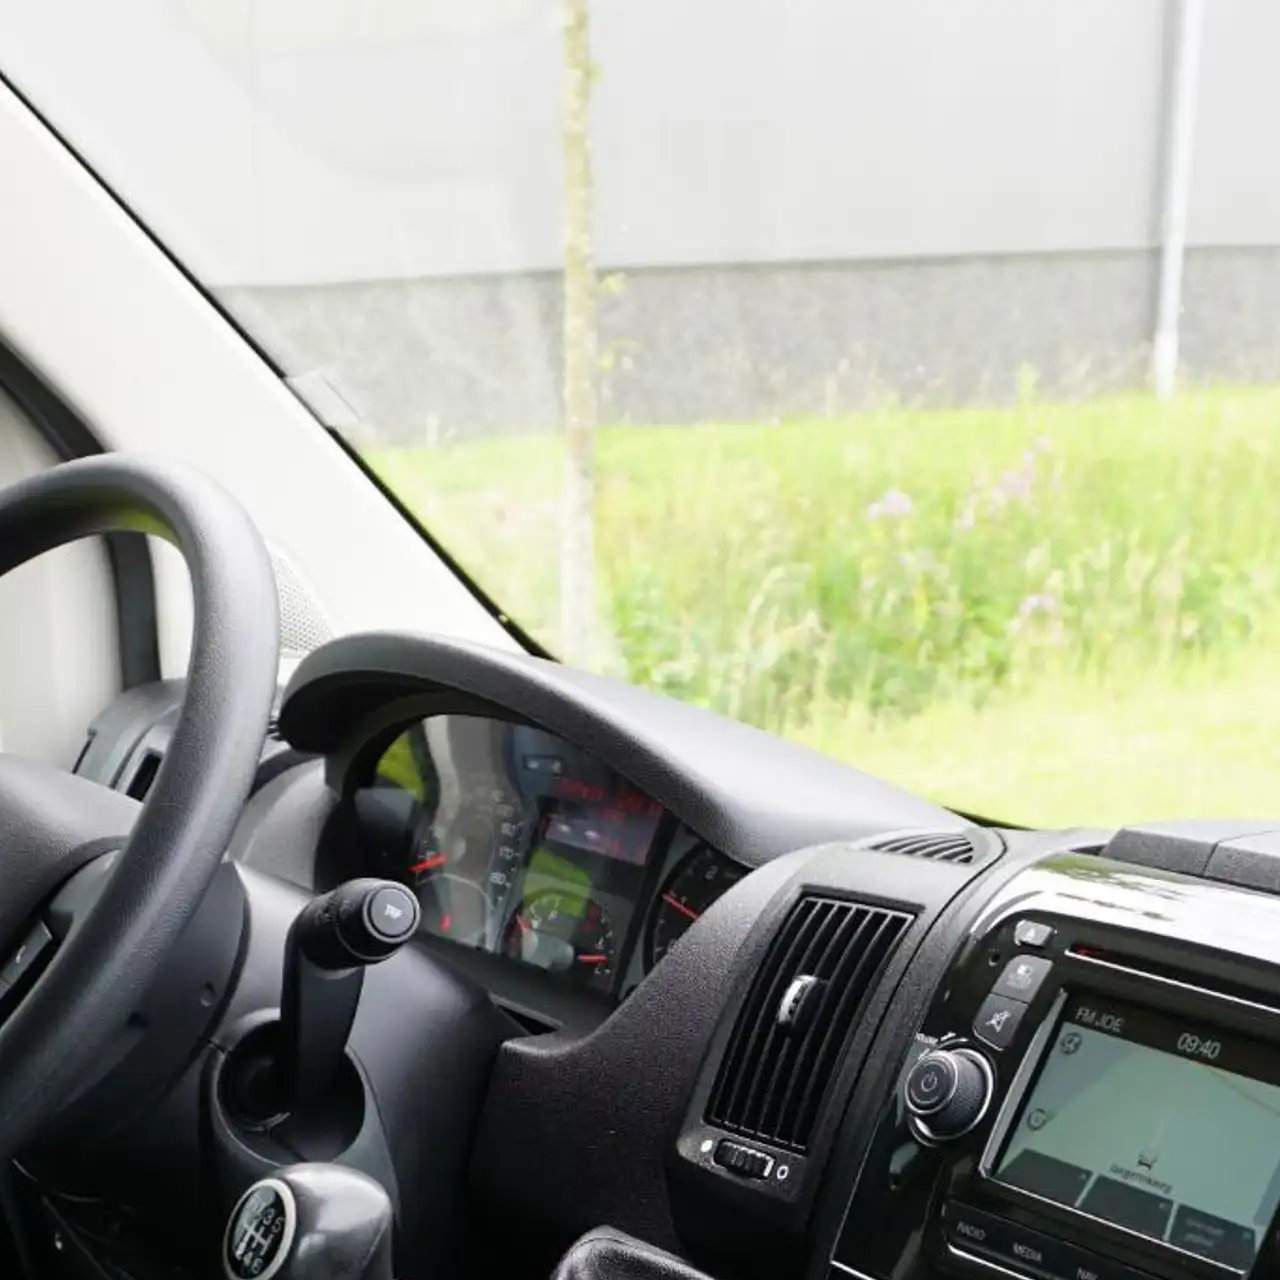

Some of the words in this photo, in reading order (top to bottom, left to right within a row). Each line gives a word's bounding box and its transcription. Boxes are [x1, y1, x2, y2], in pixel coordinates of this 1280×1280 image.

[1177, 1032, 1221, 1059] 09:40
[956, 1220, 987, 1241] RADIO
[1012, 1241, 1042, 1264] MEDIA
